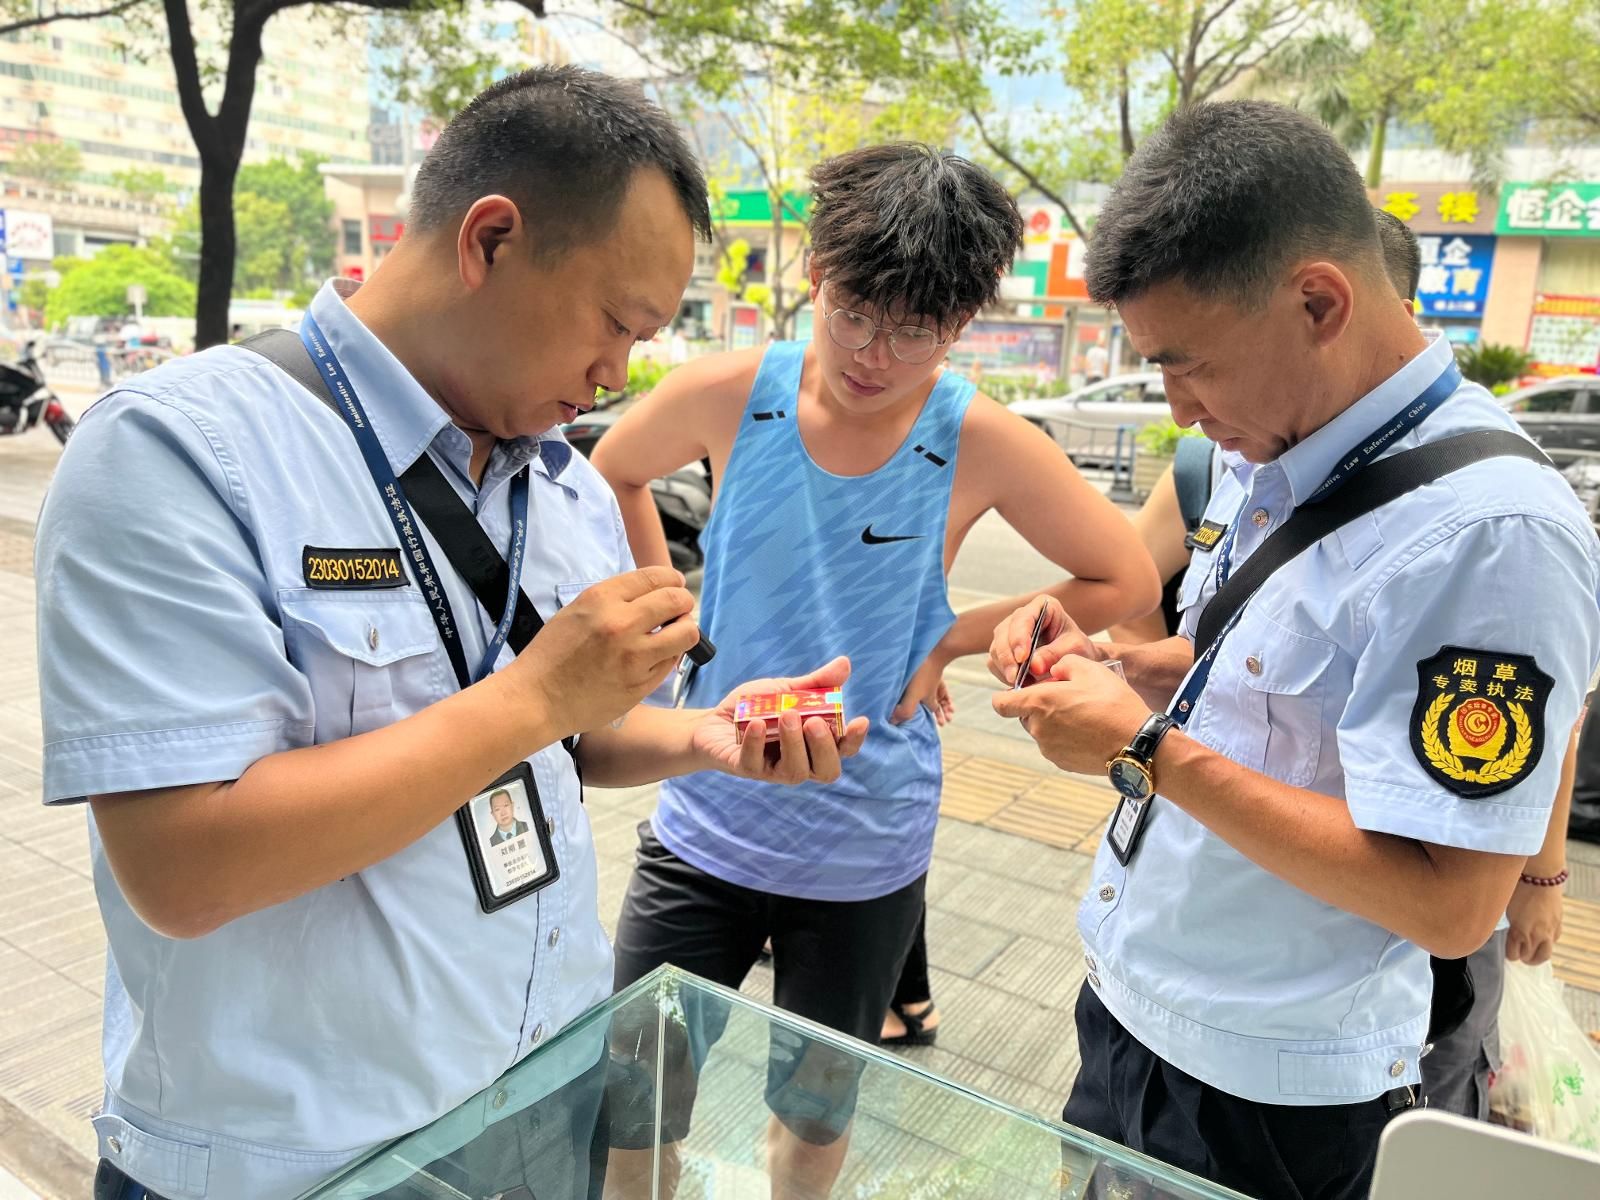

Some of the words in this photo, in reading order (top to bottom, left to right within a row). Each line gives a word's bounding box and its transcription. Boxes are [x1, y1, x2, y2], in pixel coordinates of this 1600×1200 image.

[325, 362, 337, 377] Law
[336, 380, 365, 428] Administrative
[1343, 455, 1360, 471] Law
[1362, 420, 1405, 455] Enforcement
[1408, 401, 1428, 418] China
[308, 557, 400, 580] 23030152014
[1453, 658, 1518, 682] 烟草
[1432, 674, 1534, 701] 专卖执法
